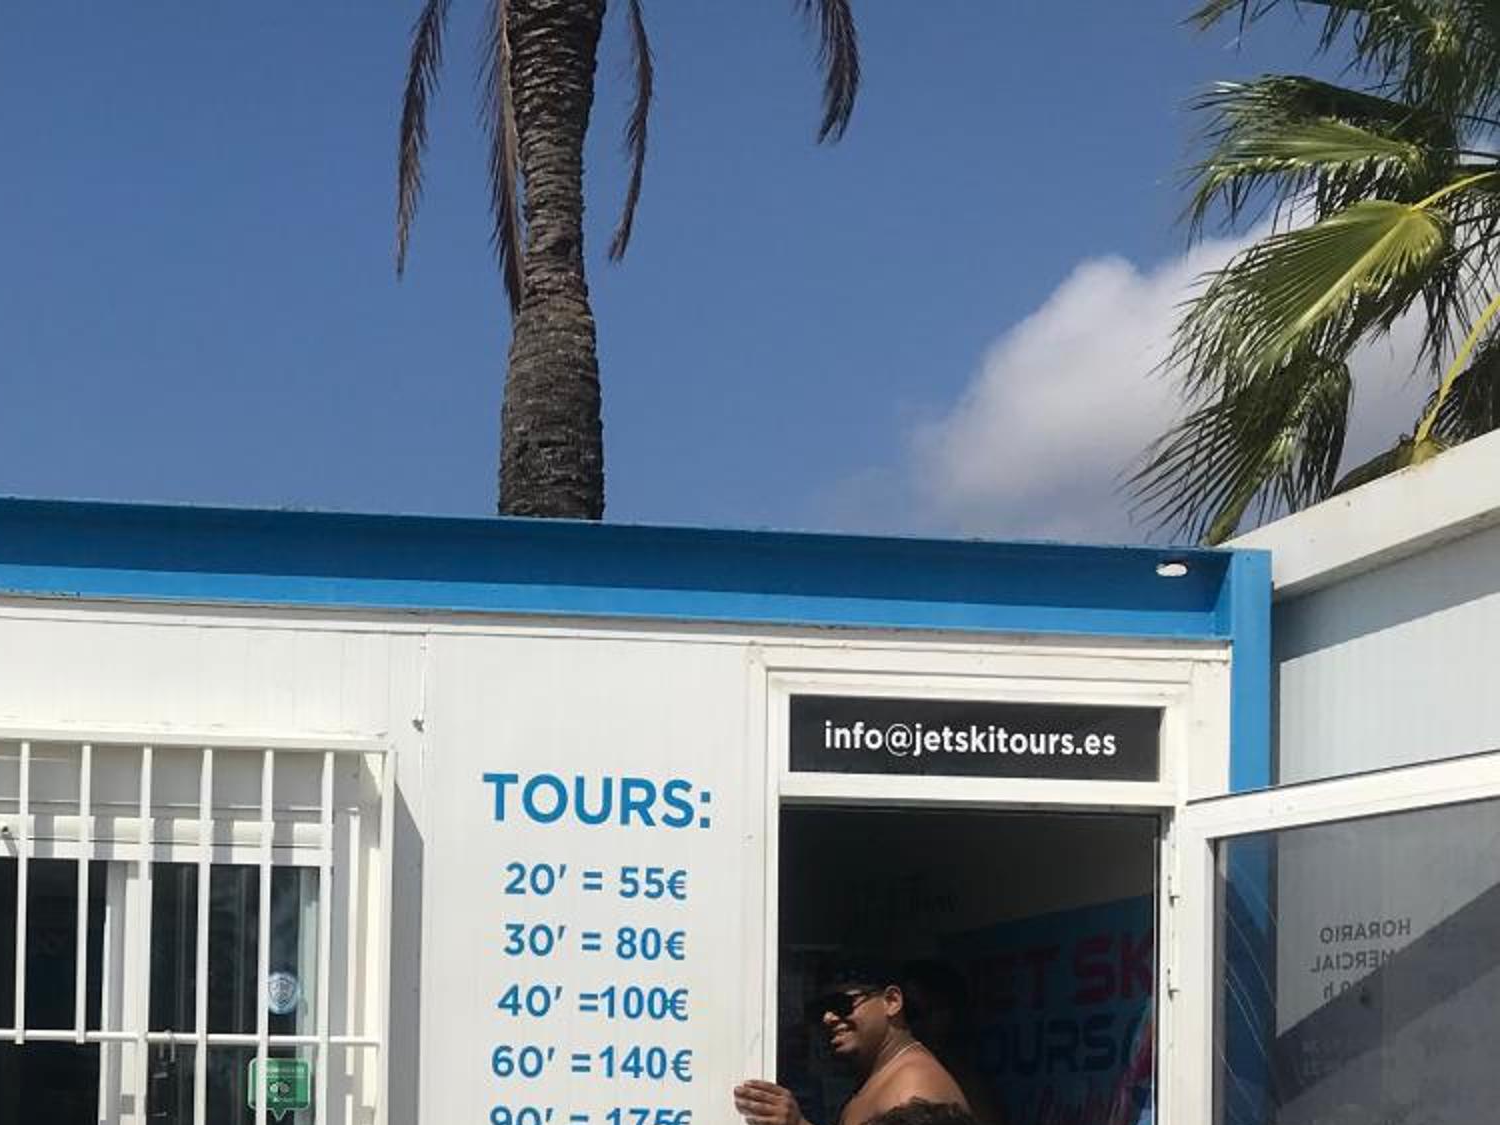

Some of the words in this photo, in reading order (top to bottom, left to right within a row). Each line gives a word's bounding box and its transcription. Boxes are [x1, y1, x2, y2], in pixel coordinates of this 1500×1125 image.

[824, 719, 1117, 757] info@jetskitours.es
[483, 773, 710, 828] TOURS:
[505, 862, 566, 896] 20'
[583, 872, 602, 890] =
[619, 866, 687, 900] 55€
[504, 924, 565, 956] 30'
[582, 932, 601, 951] =
[616, 927, 685, 960] 80€
[497, 984, 562, 1018] 40'
[492, 1045, 555, 1078] 60'
